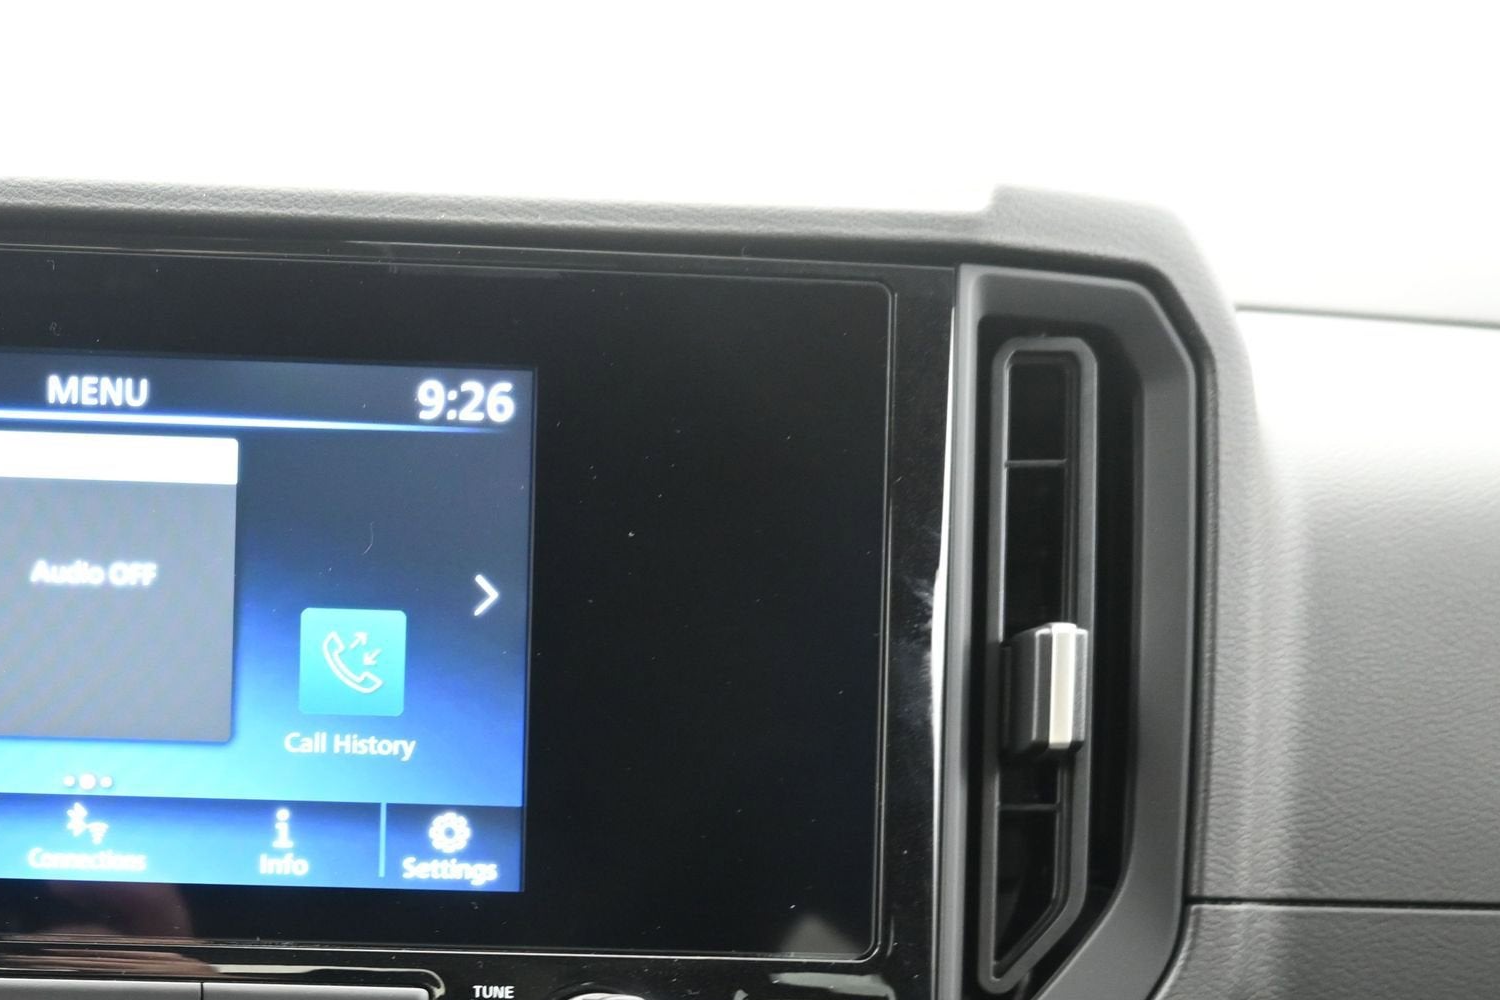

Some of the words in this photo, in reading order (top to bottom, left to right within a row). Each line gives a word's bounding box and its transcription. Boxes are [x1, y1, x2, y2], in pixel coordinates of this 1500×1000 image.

[46, 374, 150, 407] MENU
[416, 379, 516, 423] 9:26
[30, 558, 105, 586] Audio
[108, 562, 157, 587] OFF
[283, 731, 327, 755] Call
[333, 733, 417, 761] History
[258, 853, 309, 877] Info
[401, 856, 498, 887] Settings
[472, 984, 515, 1000] TUNE
